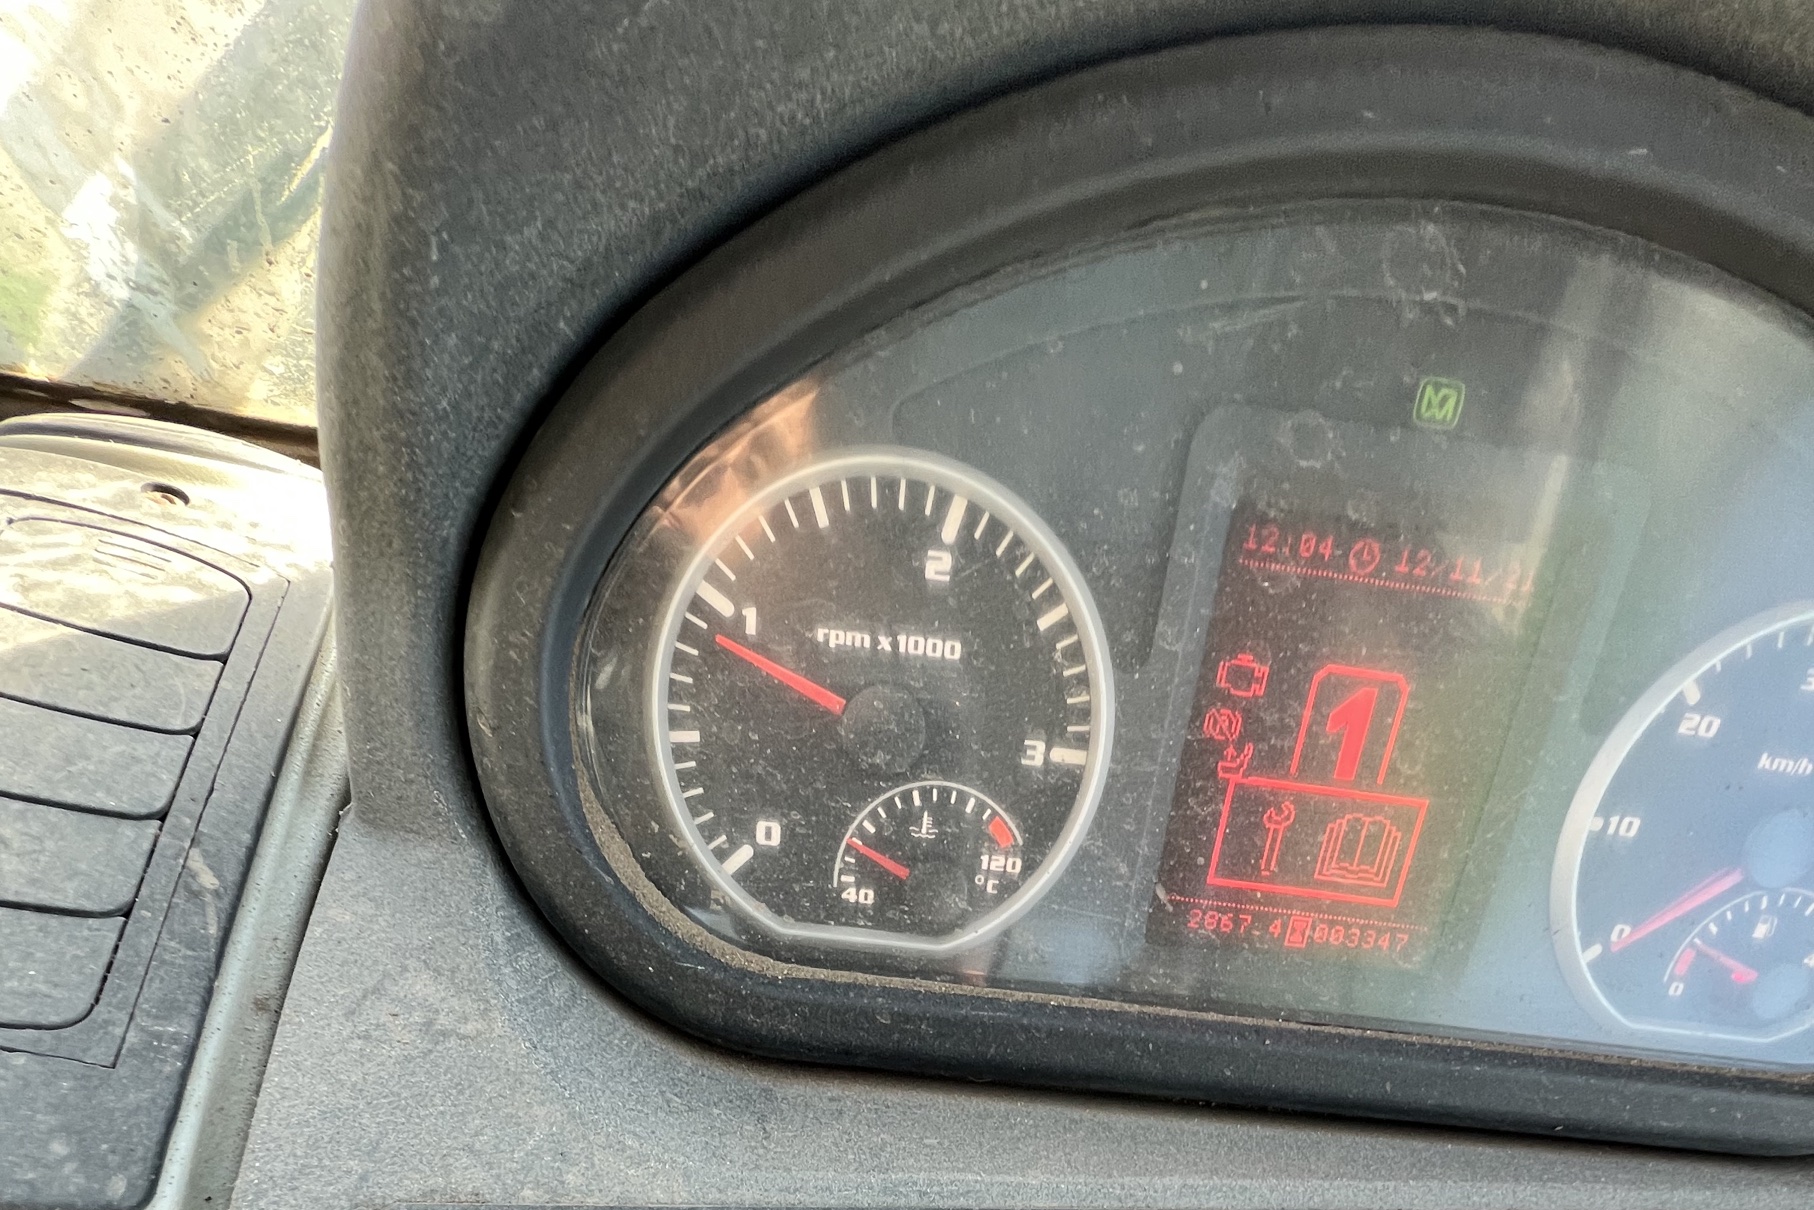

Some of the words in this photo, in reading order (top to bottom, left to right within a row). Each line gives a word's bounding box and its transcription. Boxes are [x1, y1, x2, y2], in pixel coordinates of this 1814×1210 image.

[924, 549, 952, 582] 2
[742, 606, 757, 635] 1
[816, 627, 871, 651] rpm
[1326, 687, 1378, 782] 1
[1678, 712, 1721, 738] 20
[1021, 738, 1045, 766] 3
[1757, 751, 1813, 776] km/h
[755, 820, 781, 846] 0
[1606, 815, 1640, 838] 10
[979, 853, 1023, 874] 120
[840, 887, 875, 905] 40
[1610, 923, 1632, 944] 0
[1668, 980, 1684, 997] 0
